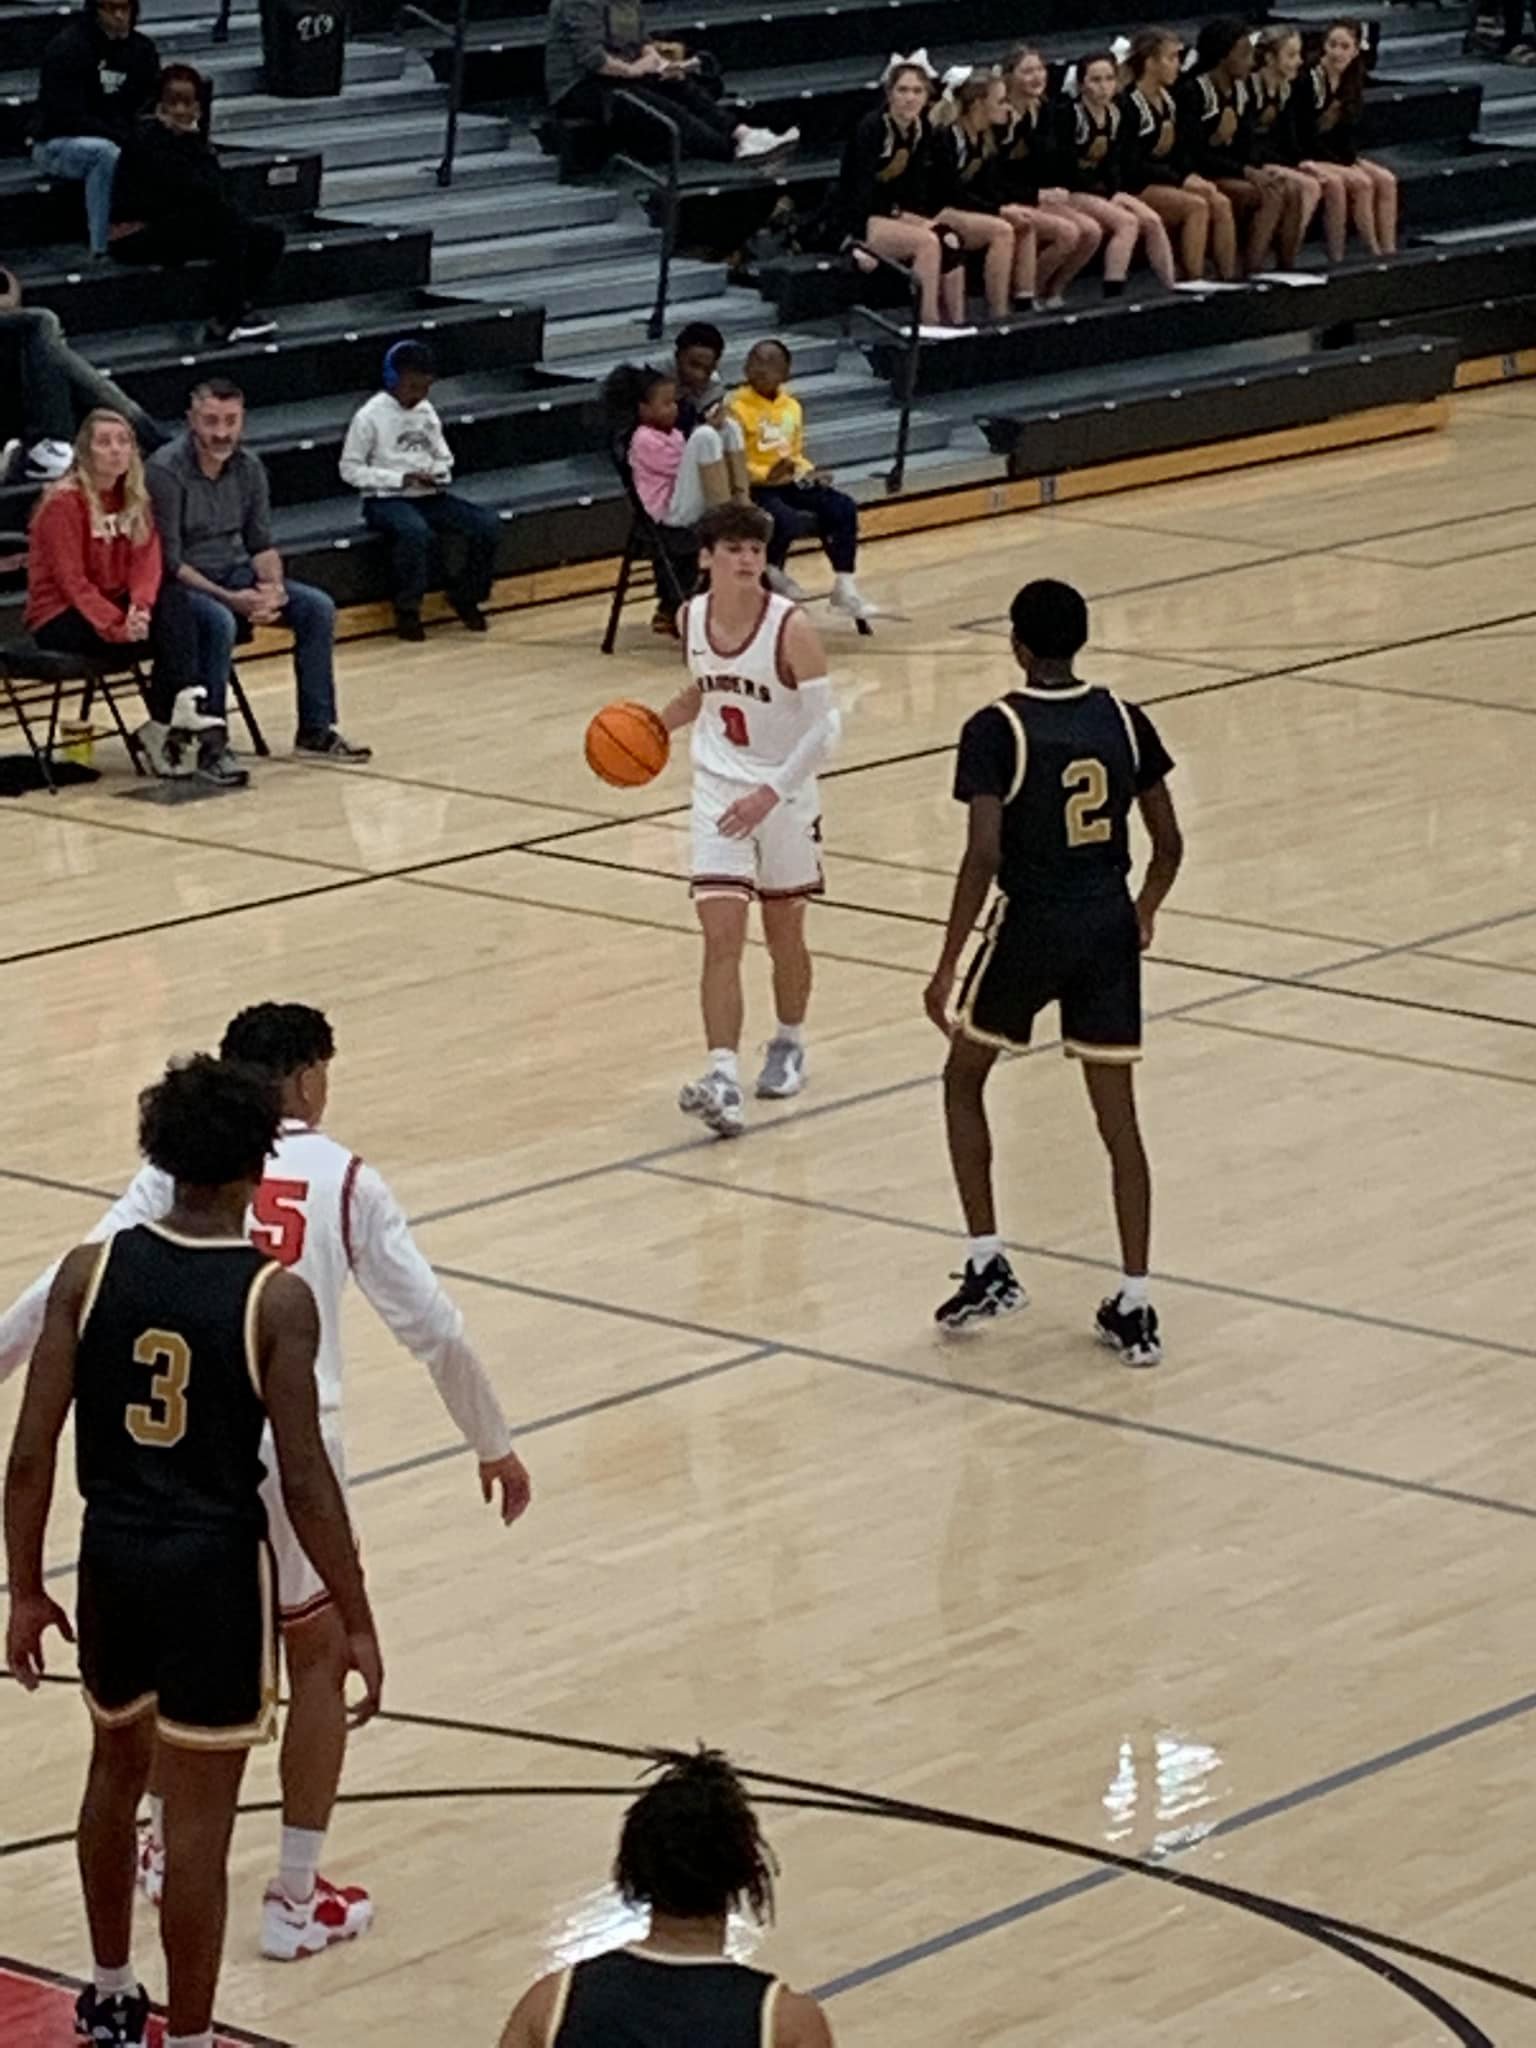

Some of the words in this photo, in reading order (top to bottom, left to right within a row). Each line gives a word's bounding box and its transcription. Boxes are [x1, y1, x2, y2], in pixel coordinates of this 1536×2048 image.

[1061, 758, 1111, 848] 2
[250, 1178, 309, 1267] 5
[125, 1327, 192, 1448] 3
